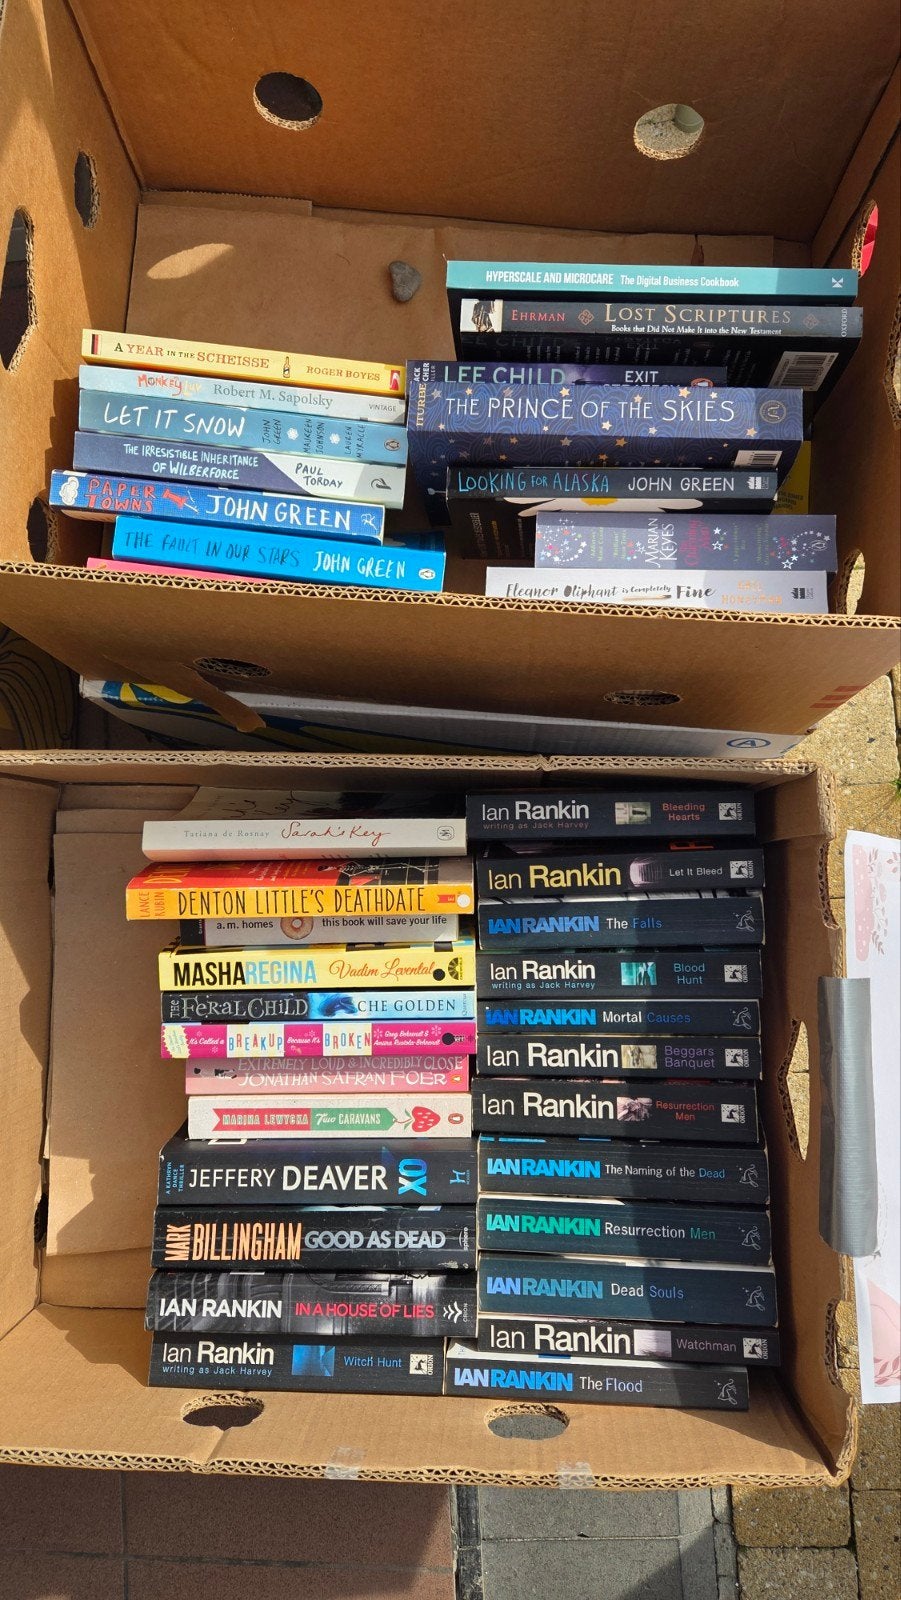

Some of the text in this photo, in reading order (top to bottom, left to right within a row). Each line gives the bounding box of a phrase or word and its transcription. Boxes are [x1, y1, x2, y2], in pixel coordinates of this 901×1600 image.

[486, 271, 613, 285] HYPERSCALE AND MICROCARE
[620, 275, 739, 288] The Digital Business Cookbook
[611, 325, 632, 333] Books
[661, 326, 674, 334] Not
[676, 326, 695, 334] Make
[705, 327, 717, 335] into
[719, 327, 728, 335] the
[730, 327, 747, 335] New
[749, 328, 782, 336] Testament
[306, 365, 380, 381] ROGER BOYES
[444, 366, 566, 385] LEE CHILD
[625, 370, 659, 383] EXIT
[213, 384, 333, 409] Robert M. Sapolsky
[416, 383, 427, 427] ITURBE
[368, 403, 397, 413] VINTAGE
[446, 398, 735, 423] THE PRINCE OF THE SKIES
[104, 402, 245, 438] LET IT SNOW
[262, 420, 271, 444] JOHN
[272, 418, 281, 446] GREEN
[123, 443, 259, 467] THE IRRESISTIBLE INHERITANCE
[152, 461, 240, 480] OF WILBERFORCE
[295, 462, 323, 477] PAUL
[87, 478, 158, 500] PAPER
[303, 475, 343, 489] TORDAY
[457, 471, 609, 493] LOOKING FOR ALASKA
[628, 477, 735, 492] JOHN GREEN
[86, 494, 154, 513] TOWNS
[205, 494, 351, 531] JOHN GREEN
[645, 517, 661, 569] MARIAN
[660, 523, 678, 562] KEYES
[313, 550, 405, 579] JOHN GREEN
[482, 800, 590, 821] Ian Rankin
[662, 803, 706, 812] Bleeding
[668, 813, 701, 821] Hearts
[184, 829, 270, 839] Tatiana de Rosnay
[138, 891, 150, 918] LANCE
[178, 887, 426, 916] DENTON LITTLE'S DEATHDATE
[242, 920, 273, 929] homes
[488, 915, 663, 934] IAN RANKIN The Falls
[328, 957, 435, 982] Vadim Levental
[490, 960, 596, 980] Ian Rankin
[673, 963, 706, 973] Blood
[677, 975, 703, 985] Hunt
[357, 998, 457, 1013] CHE GOLDEN
[602, 1010, 691, 1023] Mortal Causes
[229, 1033, 283, 1051] BREAKUP
[324, 1032, 371, 1049] BROKEN
[664, 1045, 714, 1058] Beggars
[238, 1056, 463, 1071] EXTREMELY LOUD & INCREDIBLY CLOSE
[665, 1057, 716, 1069] Banquet
[238, 1070, 447, 1087] JONATHAN SAFRAN FOER
[655, 1100, 715, 1111] Resurrection
[315, 1113, 381, 1125] Two CARAVANS
[675, 1112, 696, 1121] Men
[398, 1158, 427, 1196] XO
[487, 1158, 725, 1178] IAN RANKIN The Naming of the Dead
[189, 1166, 388, 1191] JEFFERY DEAVER
[304, 1230, 446, 1249] GOOD AS DEAD
[604, 1221, 716, 1240] Resurrection Men
[164, 1224, 191, 1261] MARK
[192, 1222, 302, 1261] BILLINGHAM
[611, 1283, 684, 1300] Dead Souls
[159, 1299, 282, 1318] IAN RANKIN
[295, 1302, 434, 1318] IN A HOUSE OF LIES
[490, 1323, 631, 1355] Ian Rankin
[676, 1338, 737, 1352] Watchman
[162, 1341, 274, 1365] Ian Rankin
[344, 1356, 402, 1368] Witch Hunt
[162, 1366, 196, 1376] writing
[214, 1366, 237, 1375] Jack
[240, 1366, 272, 1377] Harvey
[579, 1376, 643, 1393] The Flood
